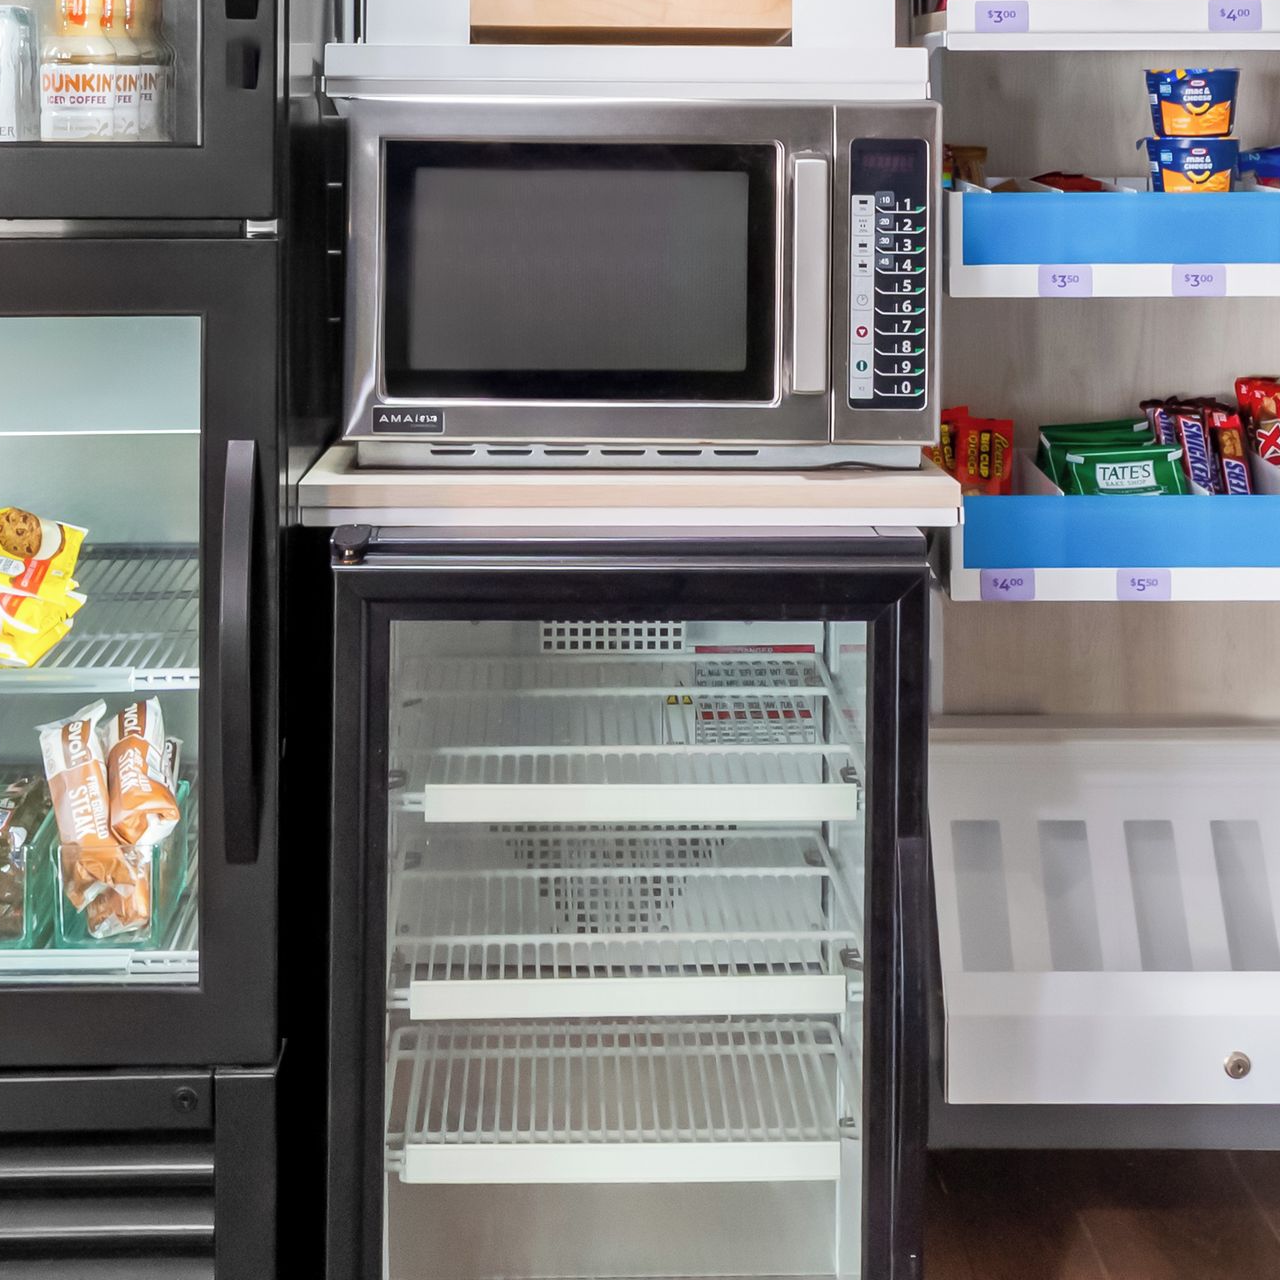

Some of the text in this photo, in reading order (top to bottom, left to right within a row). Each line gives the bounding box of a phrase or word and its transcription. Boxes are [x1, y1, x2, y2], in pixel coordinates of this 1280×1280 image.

[69, 96, 107, 104] COFFEE
[904, 199, 911, 211] 1
[903, 219, 912, 231] 2
[903, 239, 912, 251] 3
[902, 259, 912, 271] 4
[902, 279, 912, 292] 5
[902, 300, 912, 312] 6
[902, 320, 911, 332] 7
[902, 340, 911, 353] 8
[901, 361, 911, 373] 9
[901, 381, 911, 393] 0
[980, 433, 990, 477] BIG CUP
[1098, 464, 1151, 480] TATE'S
[69, 786, 96, 839] STEAK
